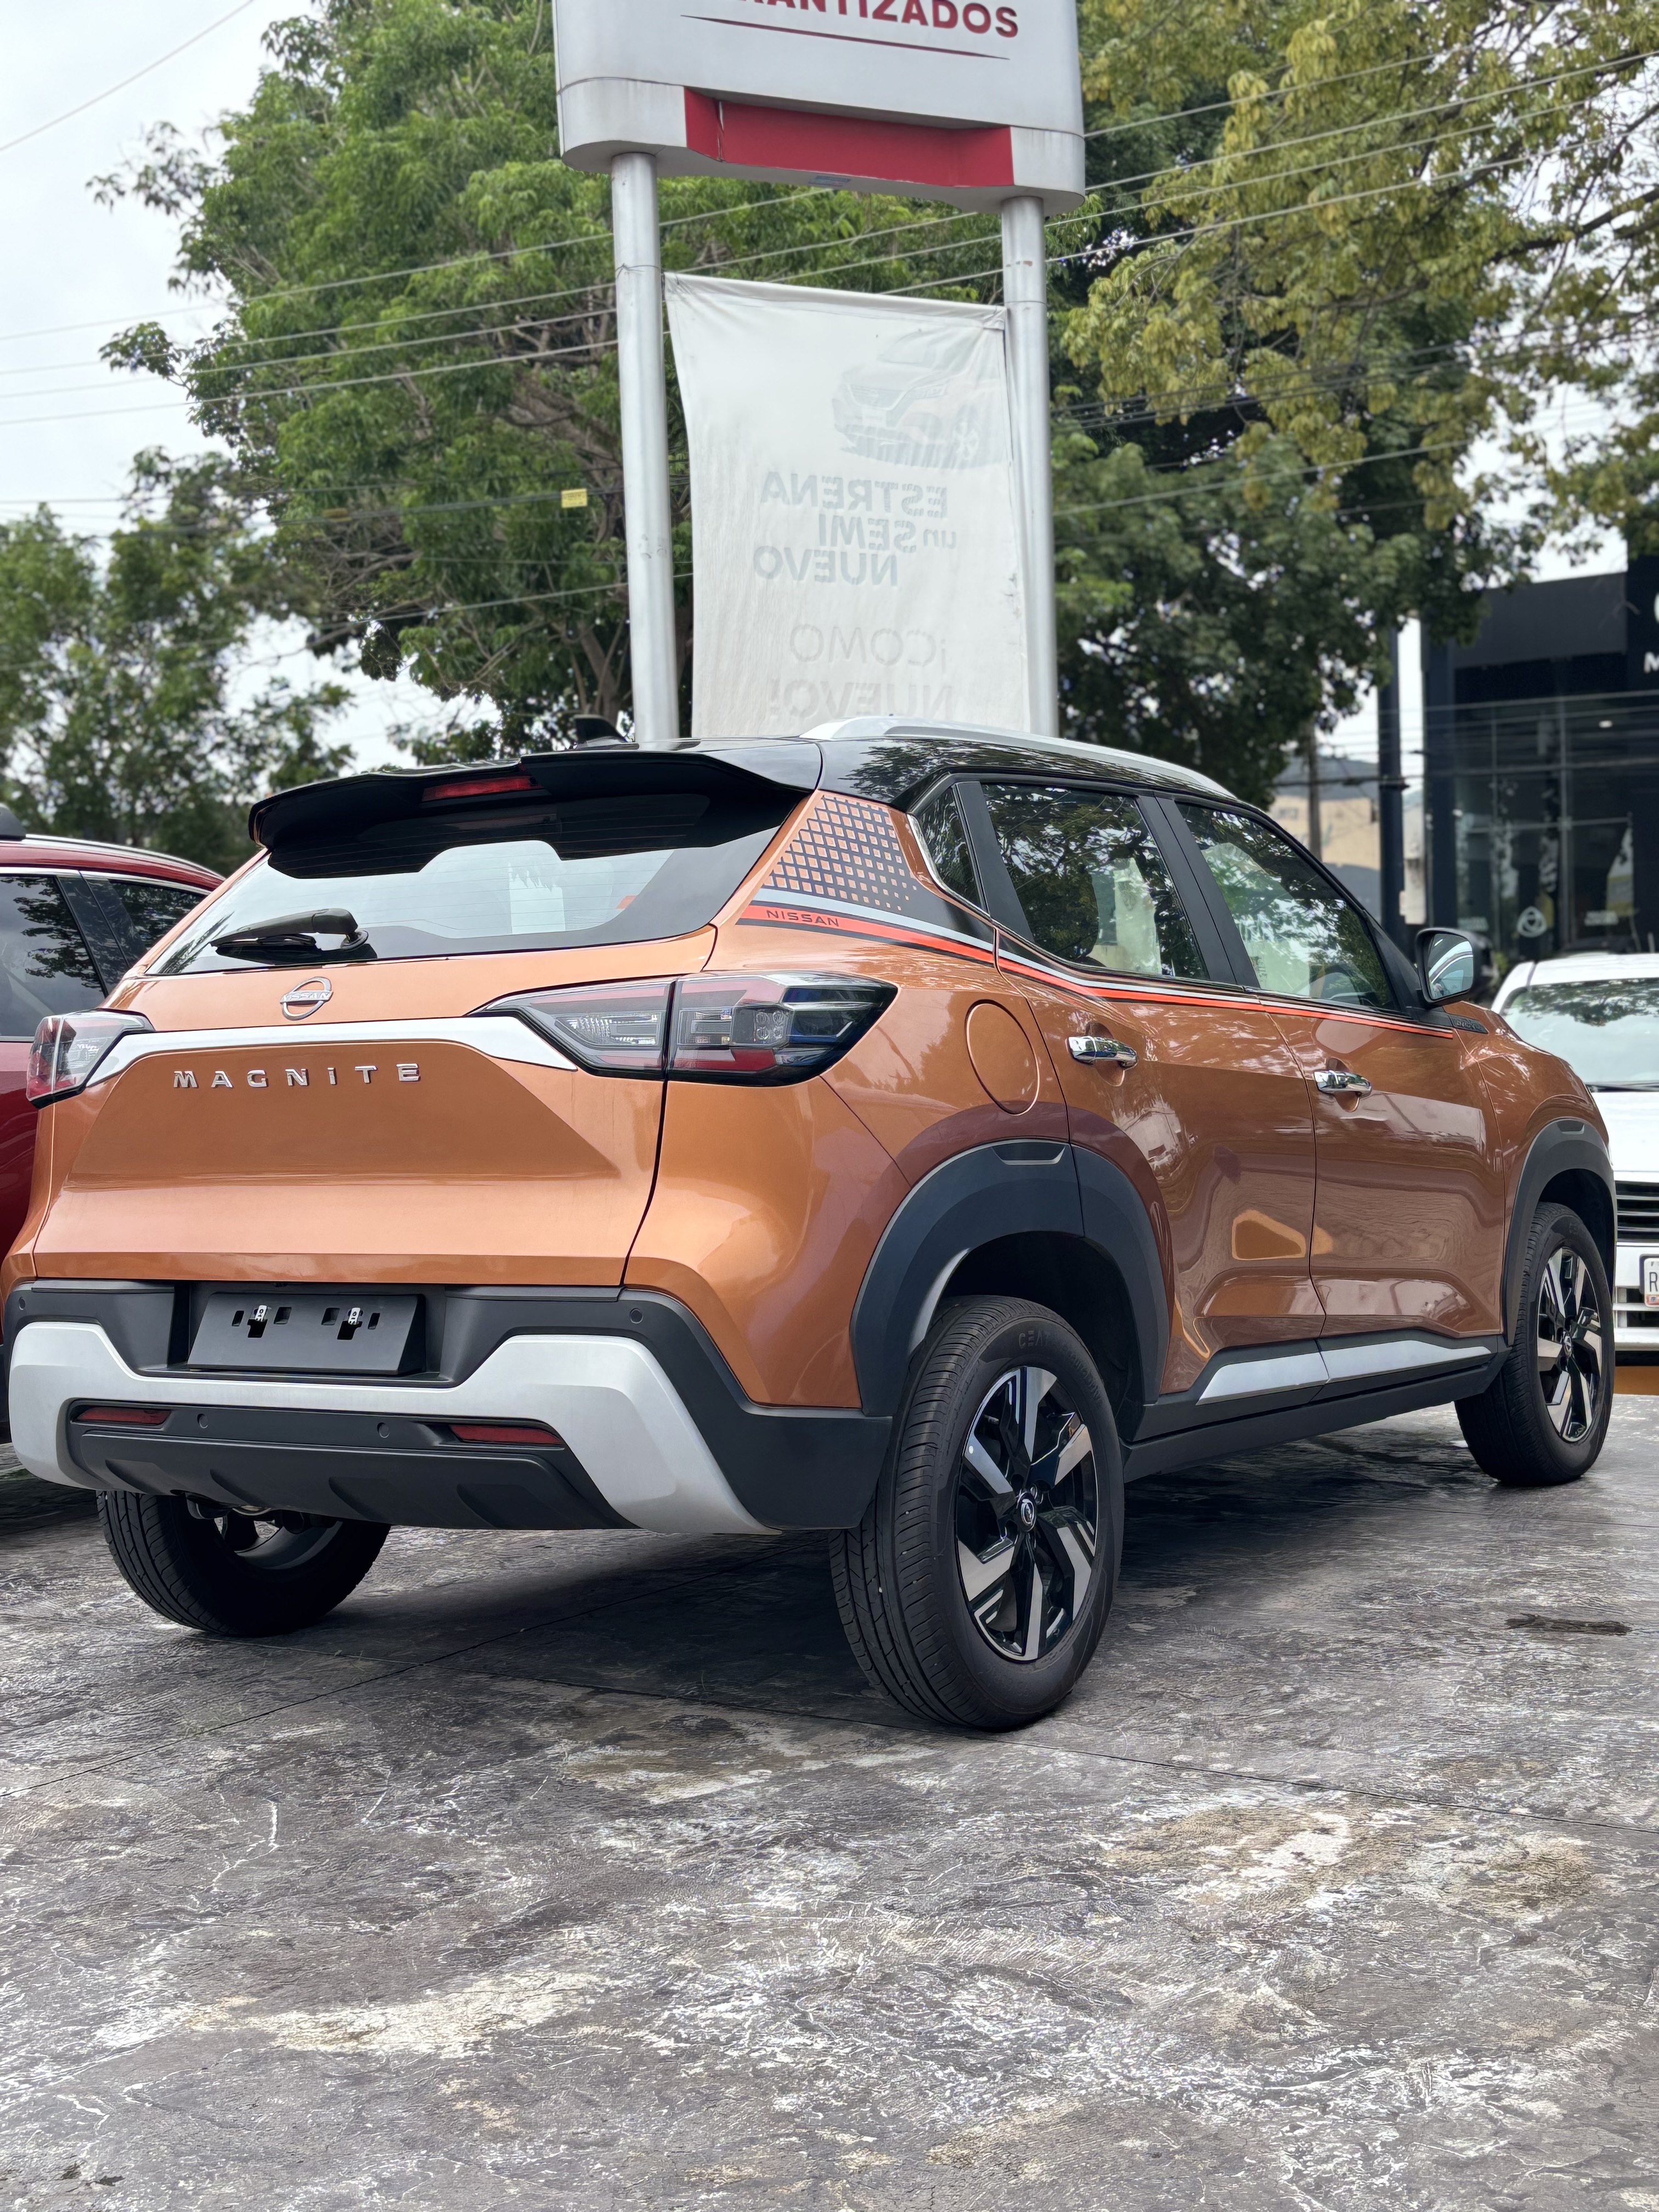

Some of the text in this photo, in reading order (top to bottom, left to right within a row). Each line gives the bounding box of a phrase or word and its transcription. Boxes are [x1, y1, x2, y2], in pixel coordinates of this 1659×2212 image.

[737, 0, 1019, 38] IZADOS
[766, 910, 839, 927] NISSAN
[173, 1063, 421, 1088] MAGNITE
